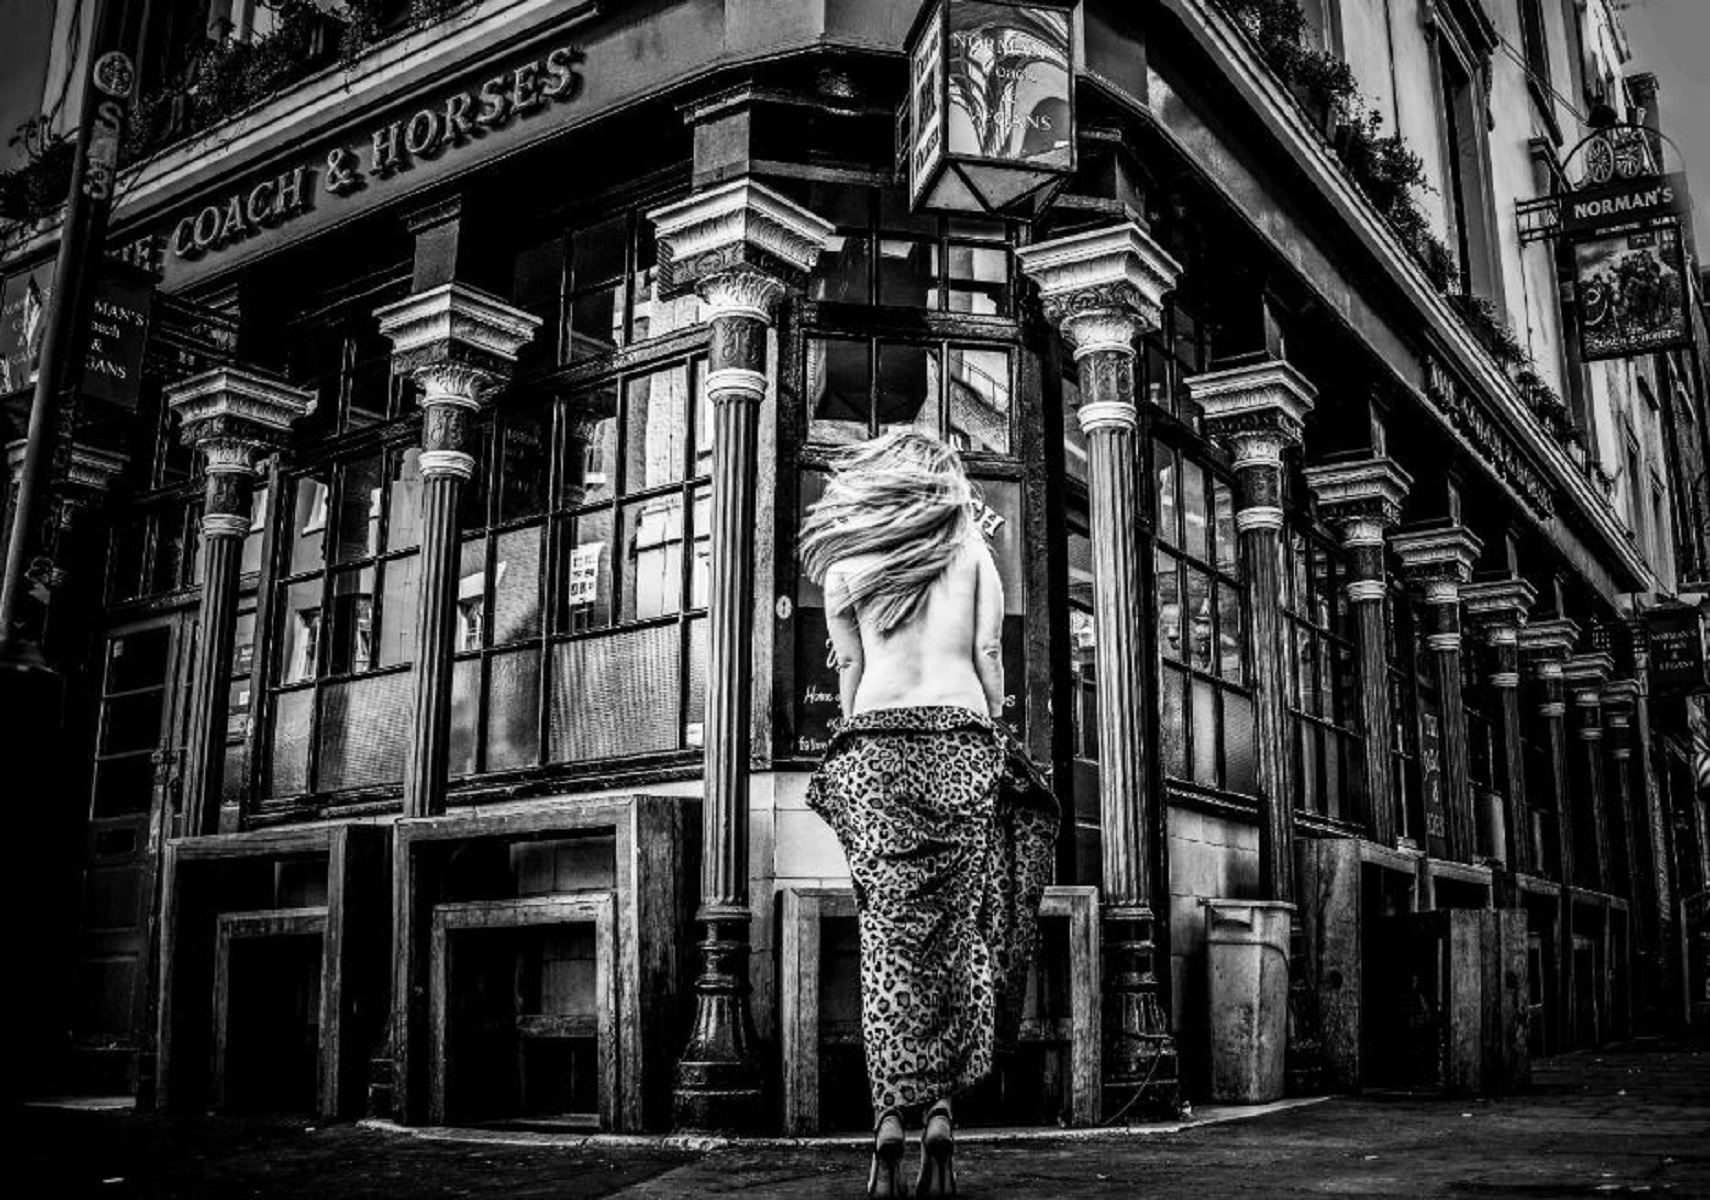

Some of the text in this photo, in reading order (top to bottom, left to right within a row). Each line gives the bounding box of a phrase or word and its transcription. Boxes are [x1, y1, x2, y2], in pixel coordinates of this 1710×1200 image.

[172, 167, 309, 258] COACH
[325, 148, 360, 194] &
[371, 46, 582, 174] HORSES
[1573, 187, 1674, 219] NORMAN'S
